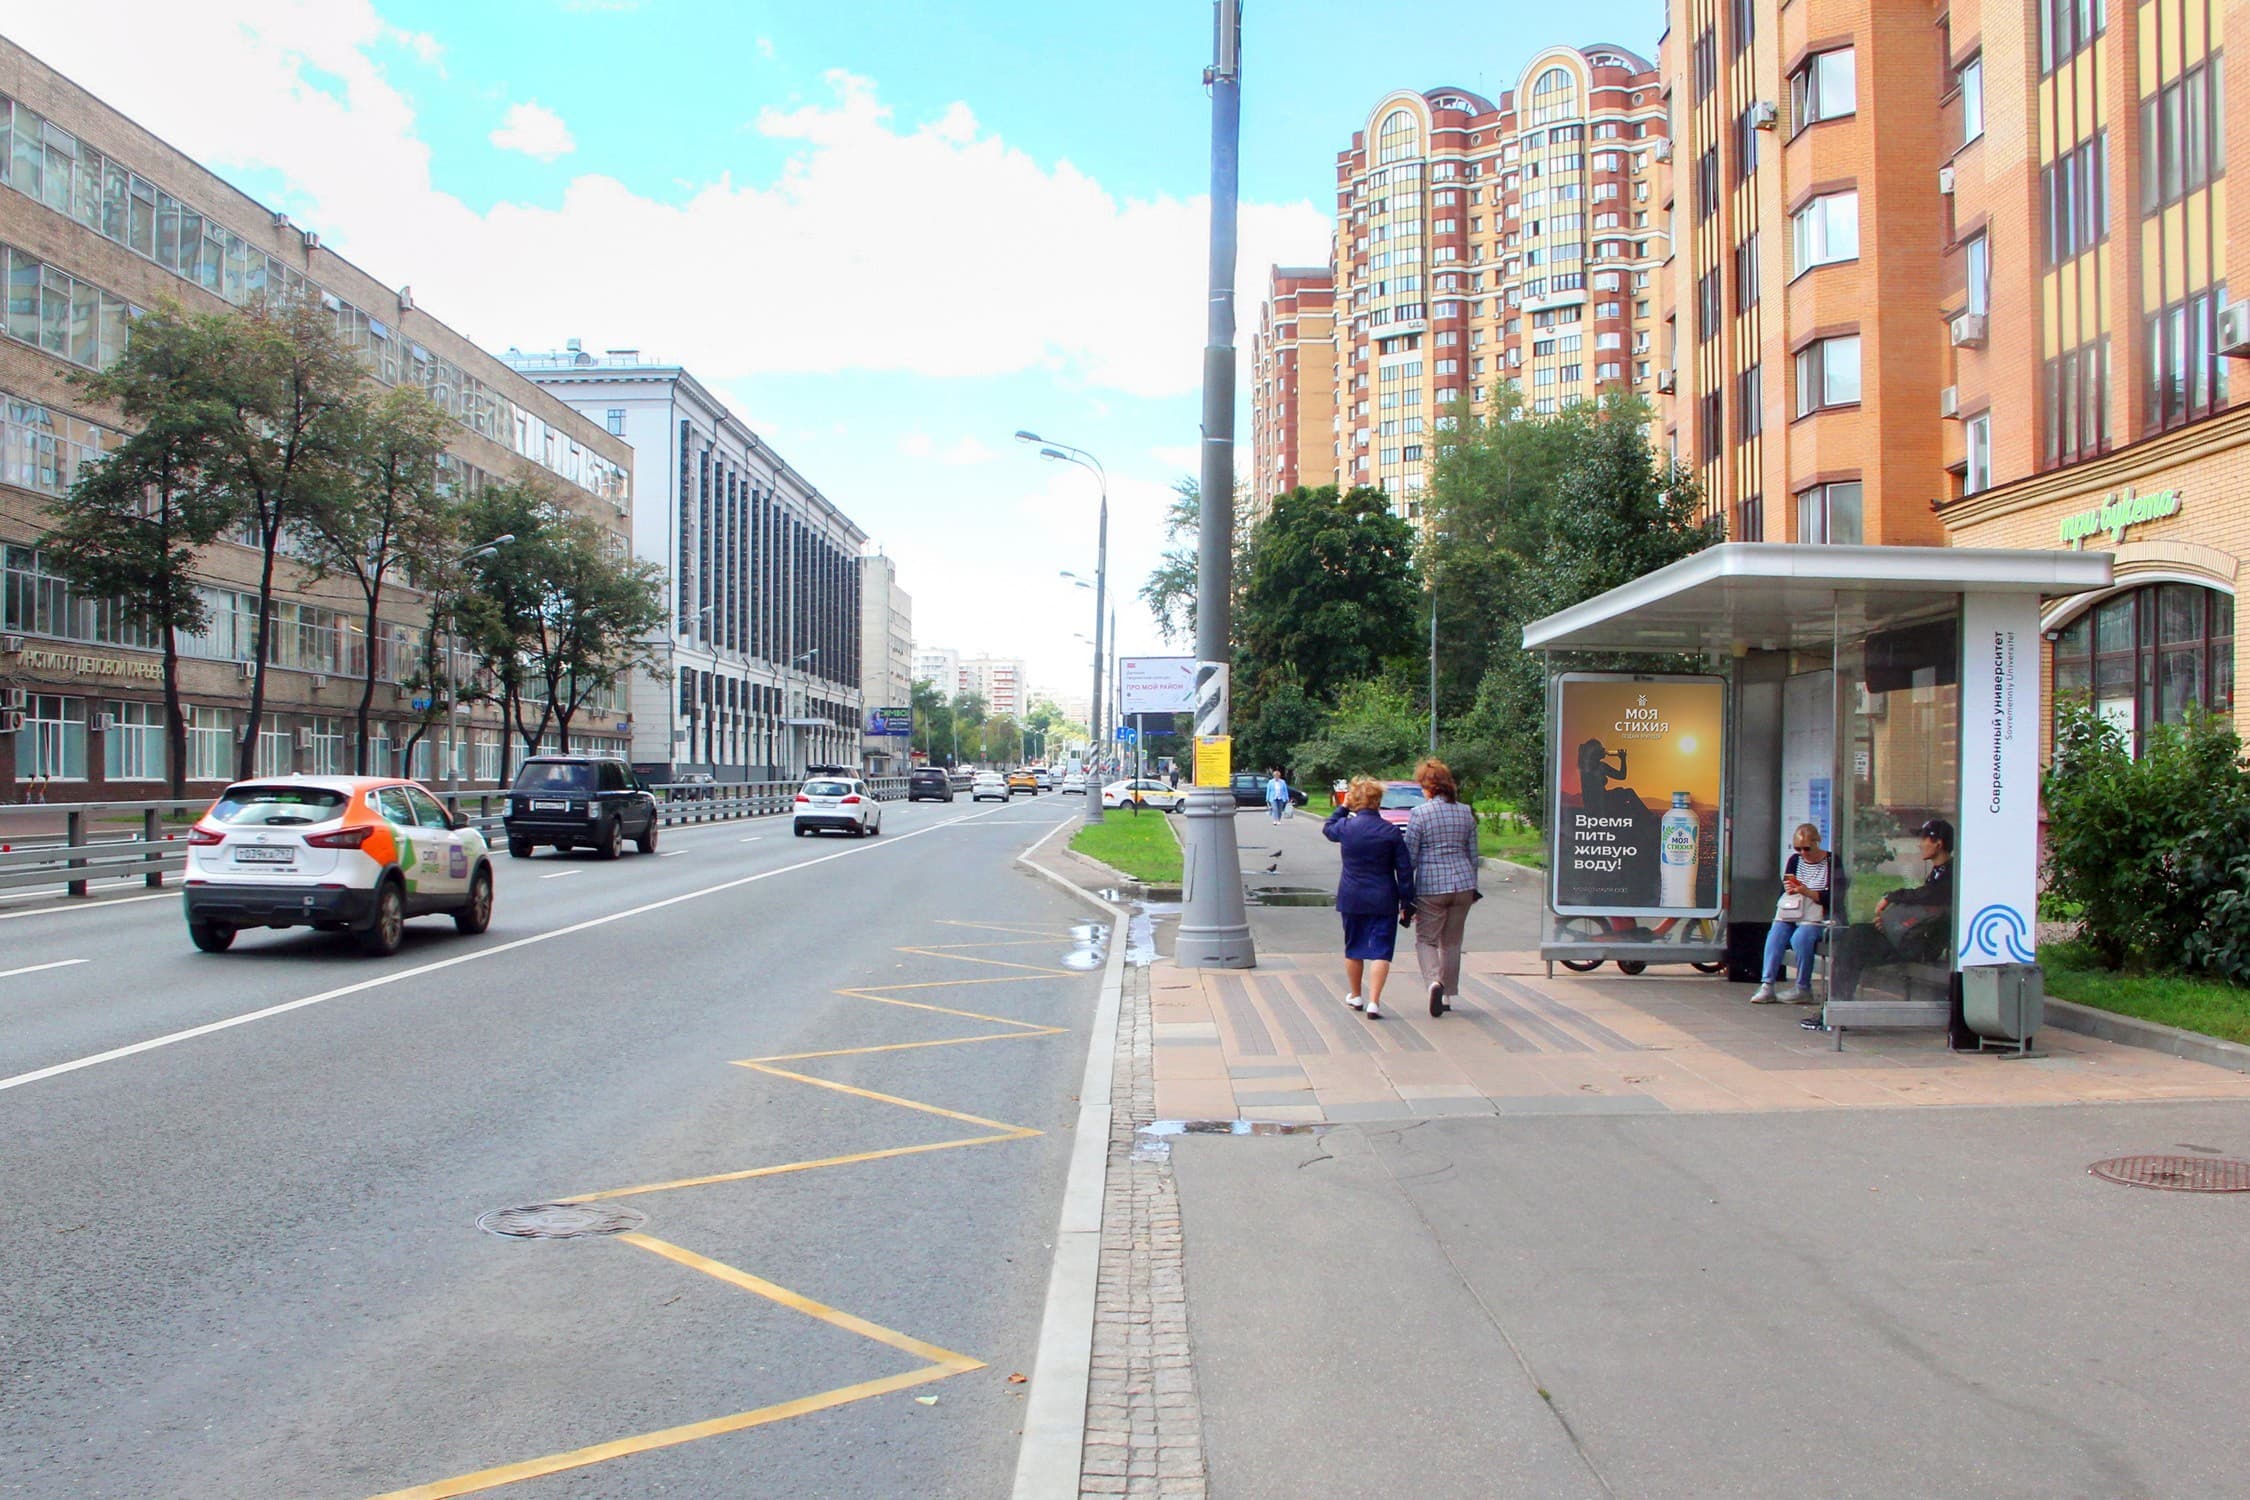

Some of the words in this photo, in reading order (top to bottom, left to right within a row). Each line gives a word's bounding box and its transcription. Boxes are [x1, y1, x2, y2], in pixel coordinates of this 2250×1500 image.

[2006, 631, 2015, 681] Universitet
[17, 650, 75, 670] ИНСТИТУТ
[77, 655, 127, 676] ДЕЛОВОЙ
[127, 661, 166, 680] КАРЬЕР
[1994, 631, 2005, 716] университет
[1625, 708, 1658, 720] МОЯ
[1614, 721, 1669, 732] СТИХИЯ
[1989, 718, 2004, 814] Современный
[1575, 814, 1633, 829] Время
[1574, 831, 1616, 841] пить
[1574, 845, 1638, 858] живую
[1574, 858, 1622, 872] воду!
